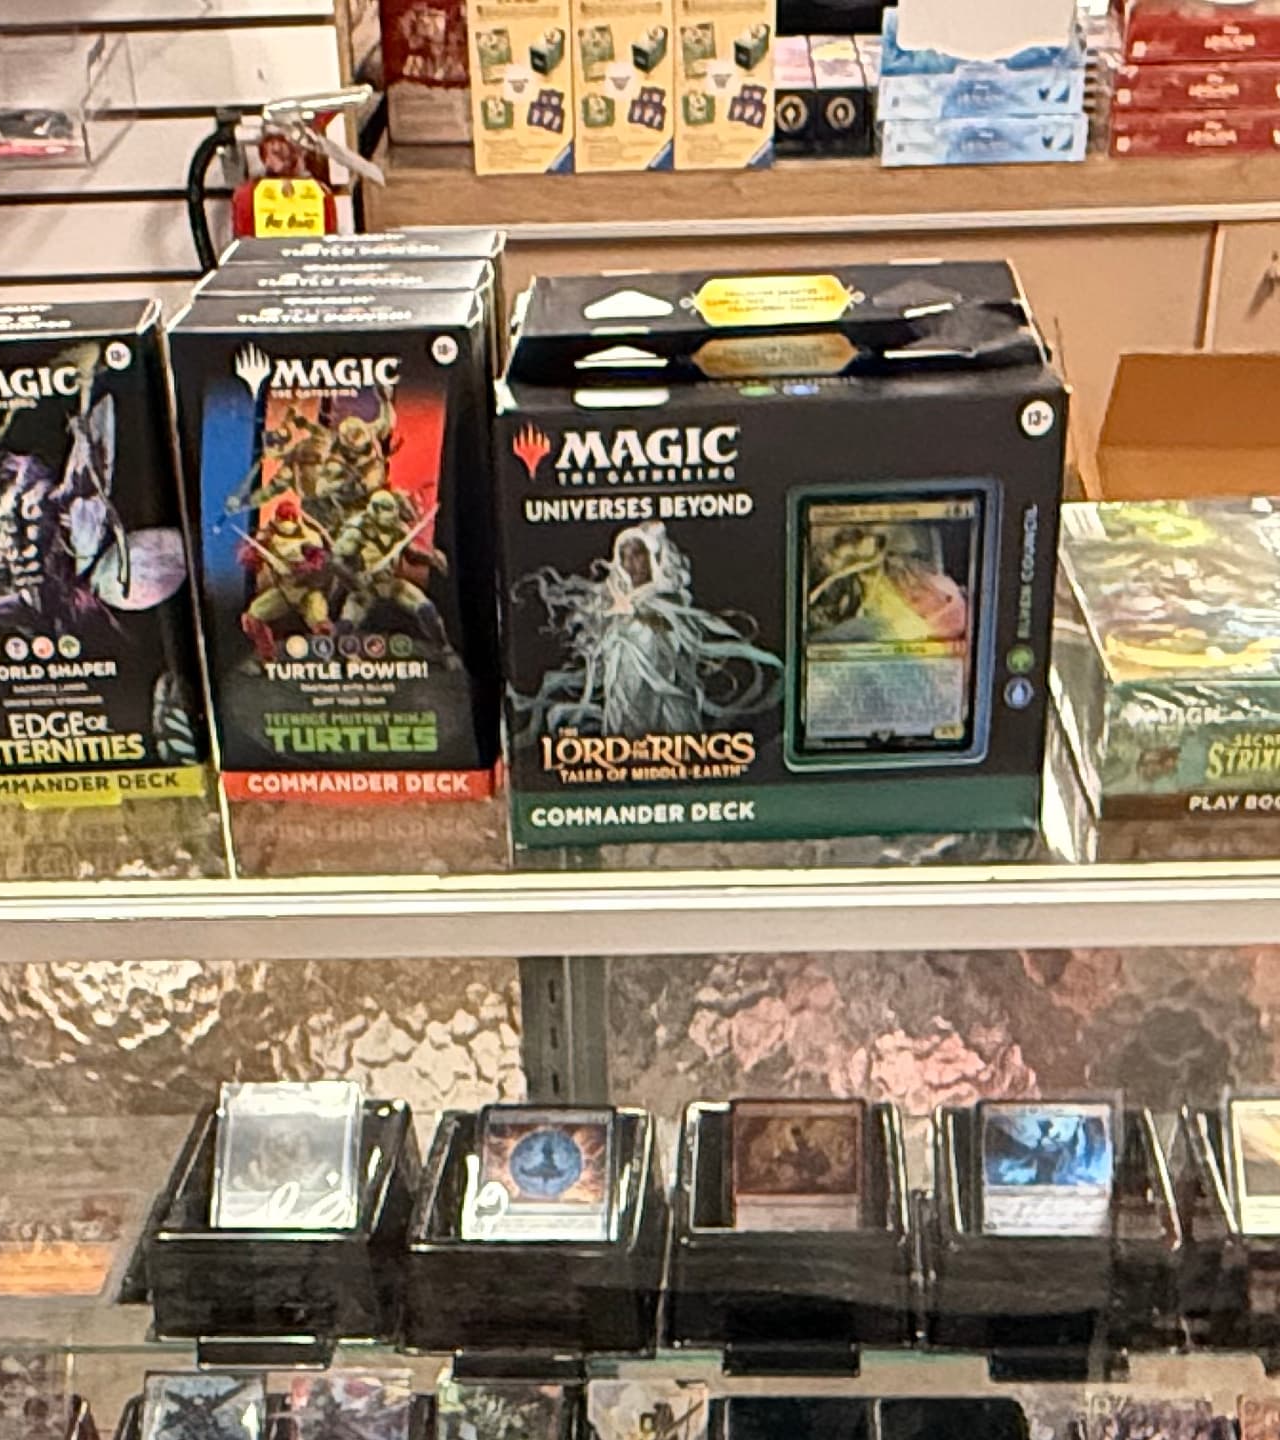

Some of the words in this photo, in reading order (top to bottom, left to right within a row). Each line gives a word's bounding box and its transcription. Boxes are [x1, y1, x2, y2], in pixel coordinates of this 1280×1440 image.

[272, 357, 402, 388] MAGIC
[555, 424, 741, 470] MAGIC
[558, 470, 596, 486] THE
[606, 465, 736, 485] GATHERING
[525, 495, 654, 522] UNIVERSES
[658, 492, 754, 519] BEYOND
[47, 661, 118, 680] SHAPER
[264, 660, 342, 682] TURTLE
[346, 660, 430, 680] POWER!
[8, 711, 84, 740] EDGE
[265, 726, 438, 753] TURTLES
[542, 734, 632, 771] LORD
[646, 732, 756, 768] RINGS
[117, 771, 179, 790] DECK
[247, 773, 400, 795] COMMANDER
[405, 773, 471, 794] DECK
[559, 767, 603, 784] TALES
[606, 766, 629, 782] OF
[530, 804, 685, 827] COMMANDER
[690, 801, 756, 822] DECK
[1188, 795, 1239, 811] PLAY
